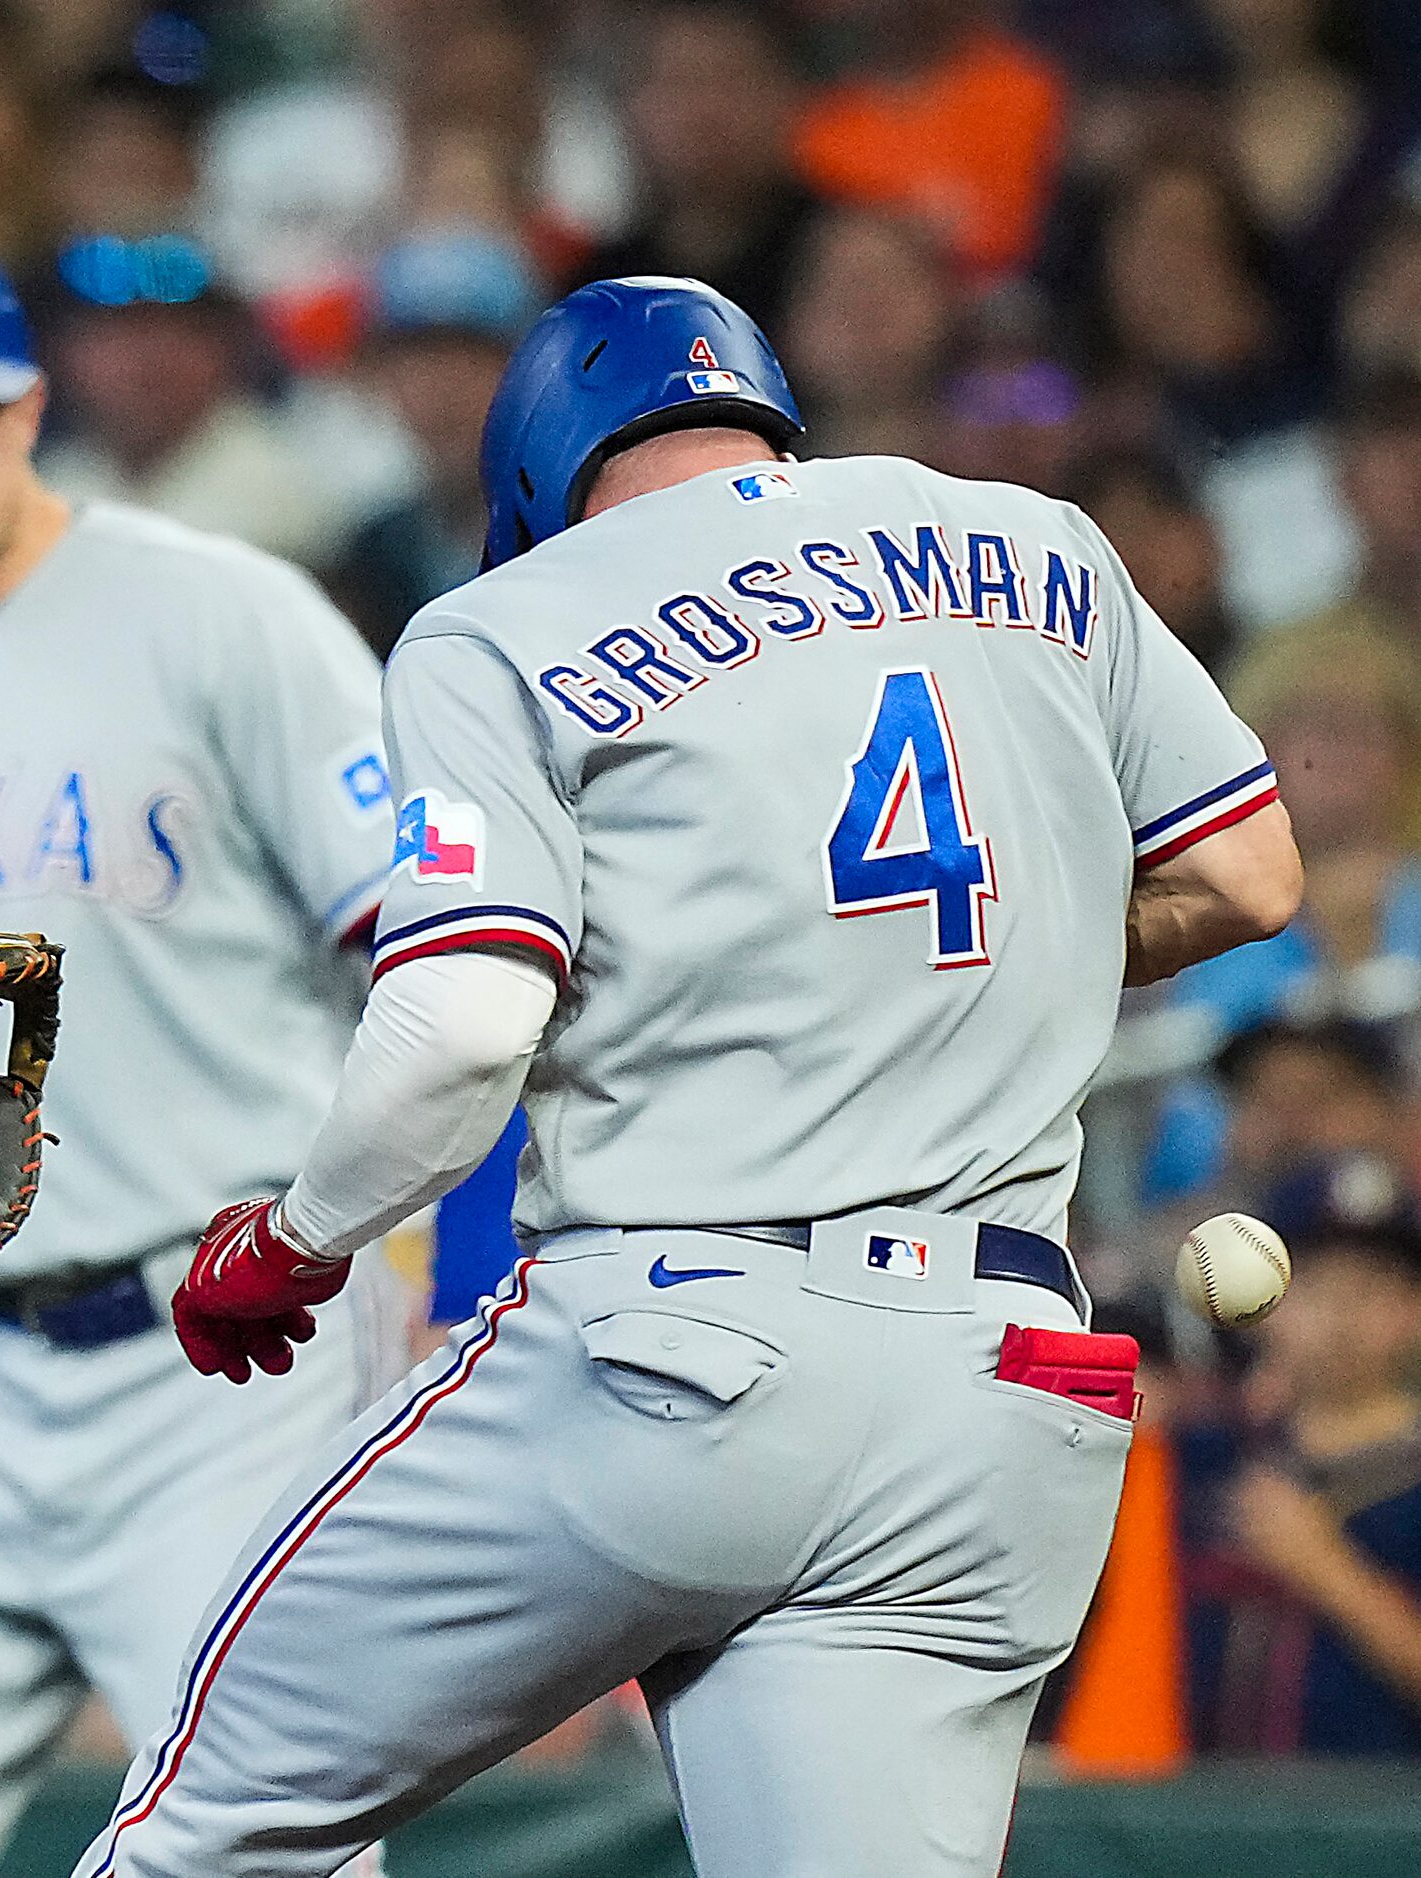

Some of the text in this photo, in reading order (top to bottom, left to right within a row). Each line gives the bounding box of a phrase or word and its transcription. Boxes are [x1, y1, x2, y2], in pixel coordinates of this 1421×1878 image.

[688, 336, 720, 369] 4
[536, 522, 1097, 739] GROSSMAN
[820, 665, 999, 971] 4
